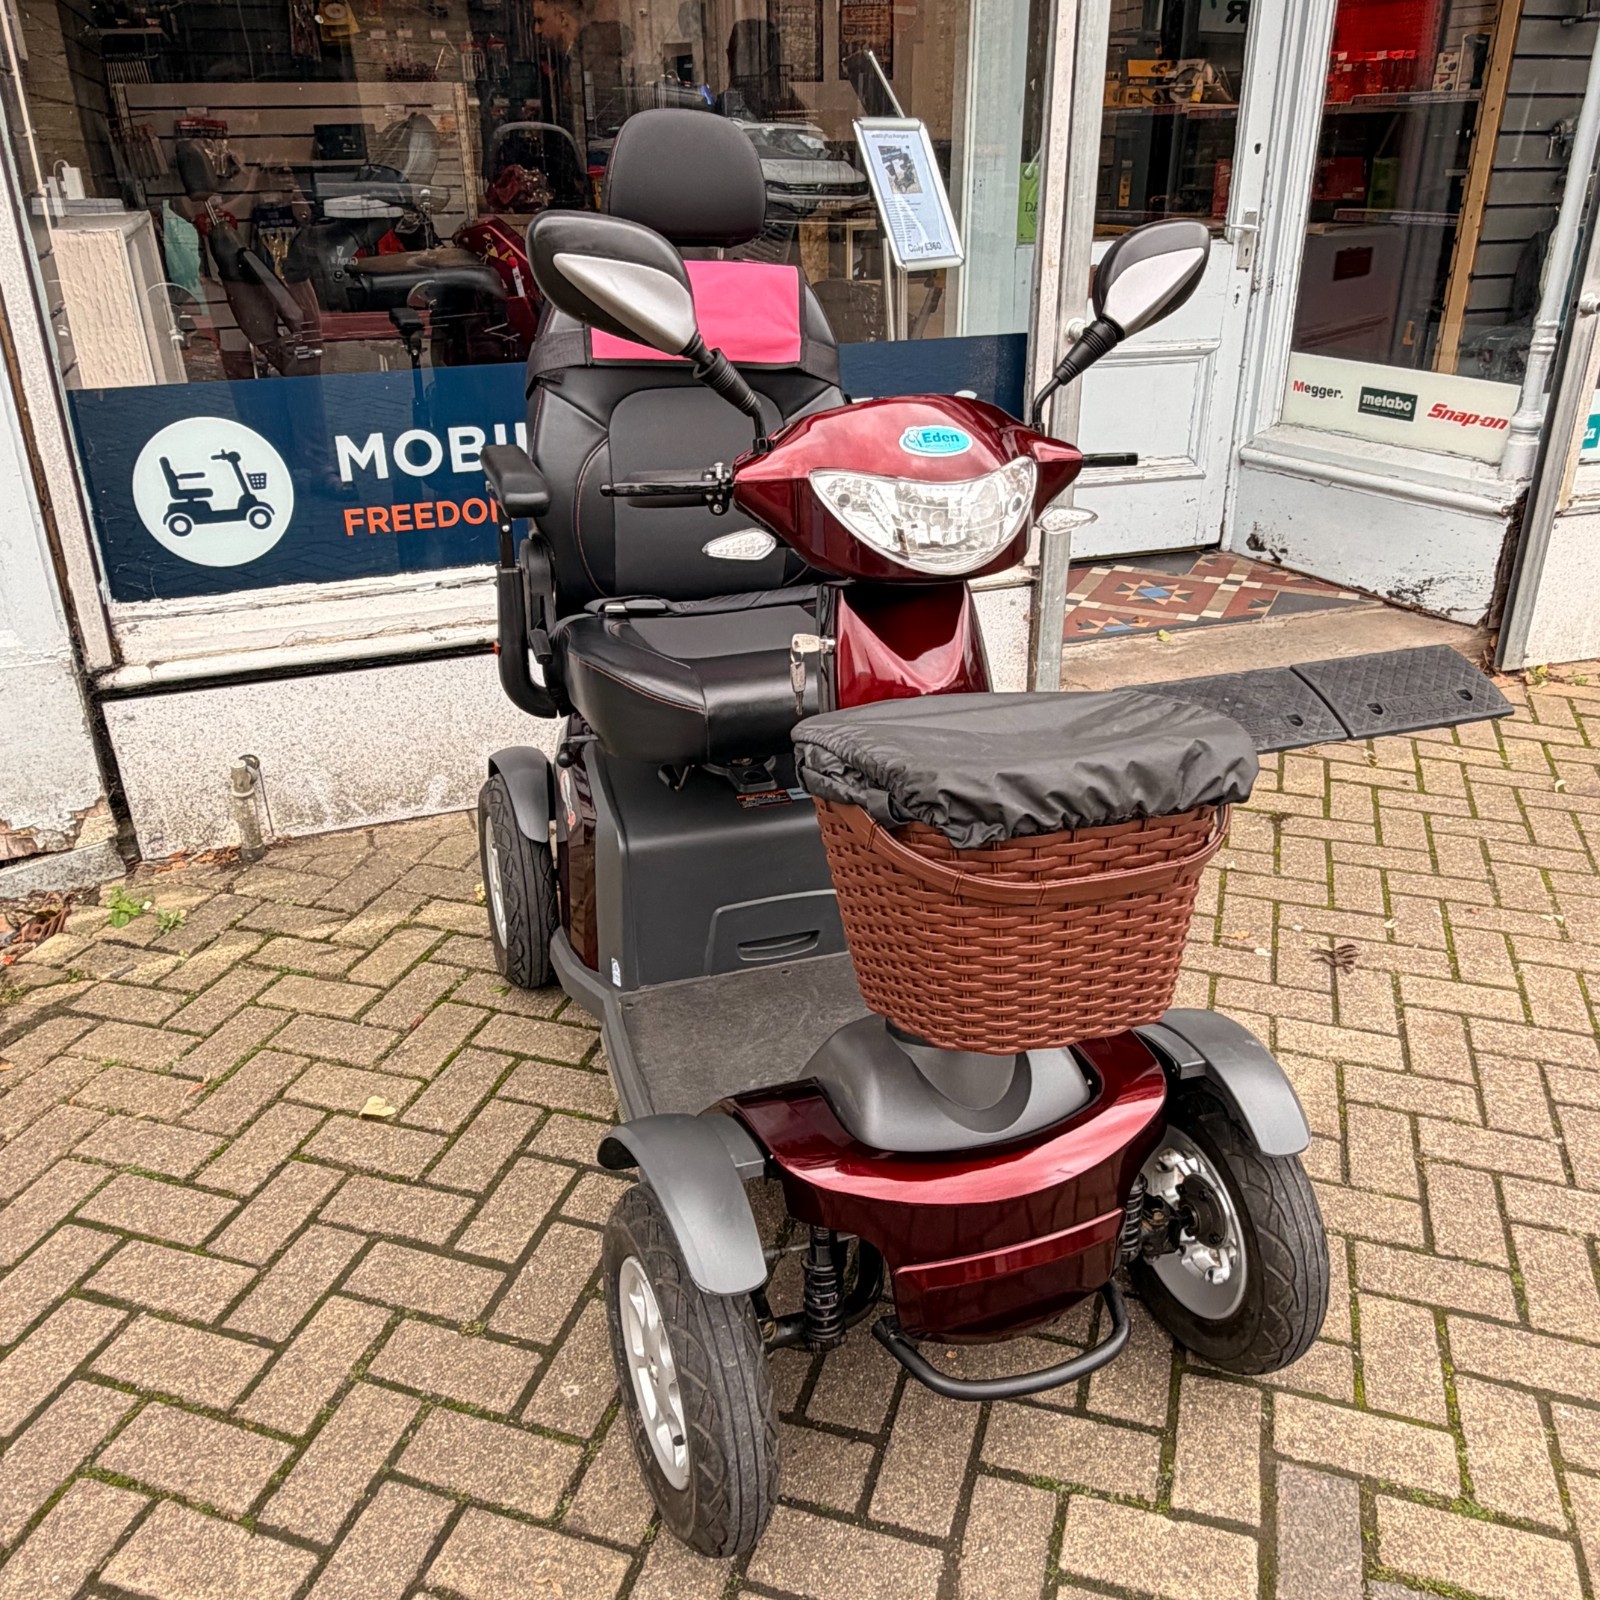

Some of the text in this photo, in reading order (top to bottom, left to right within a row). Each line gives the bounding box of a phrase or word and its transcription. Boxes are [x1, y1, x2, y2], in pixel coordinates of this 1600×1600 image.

[1362, 394, 1412, 411] metabo
[1427, 403, 1508, 430] Snap-on
[922, 432, 960, 443] Eden
[334, 422, 528, 482] MOB
